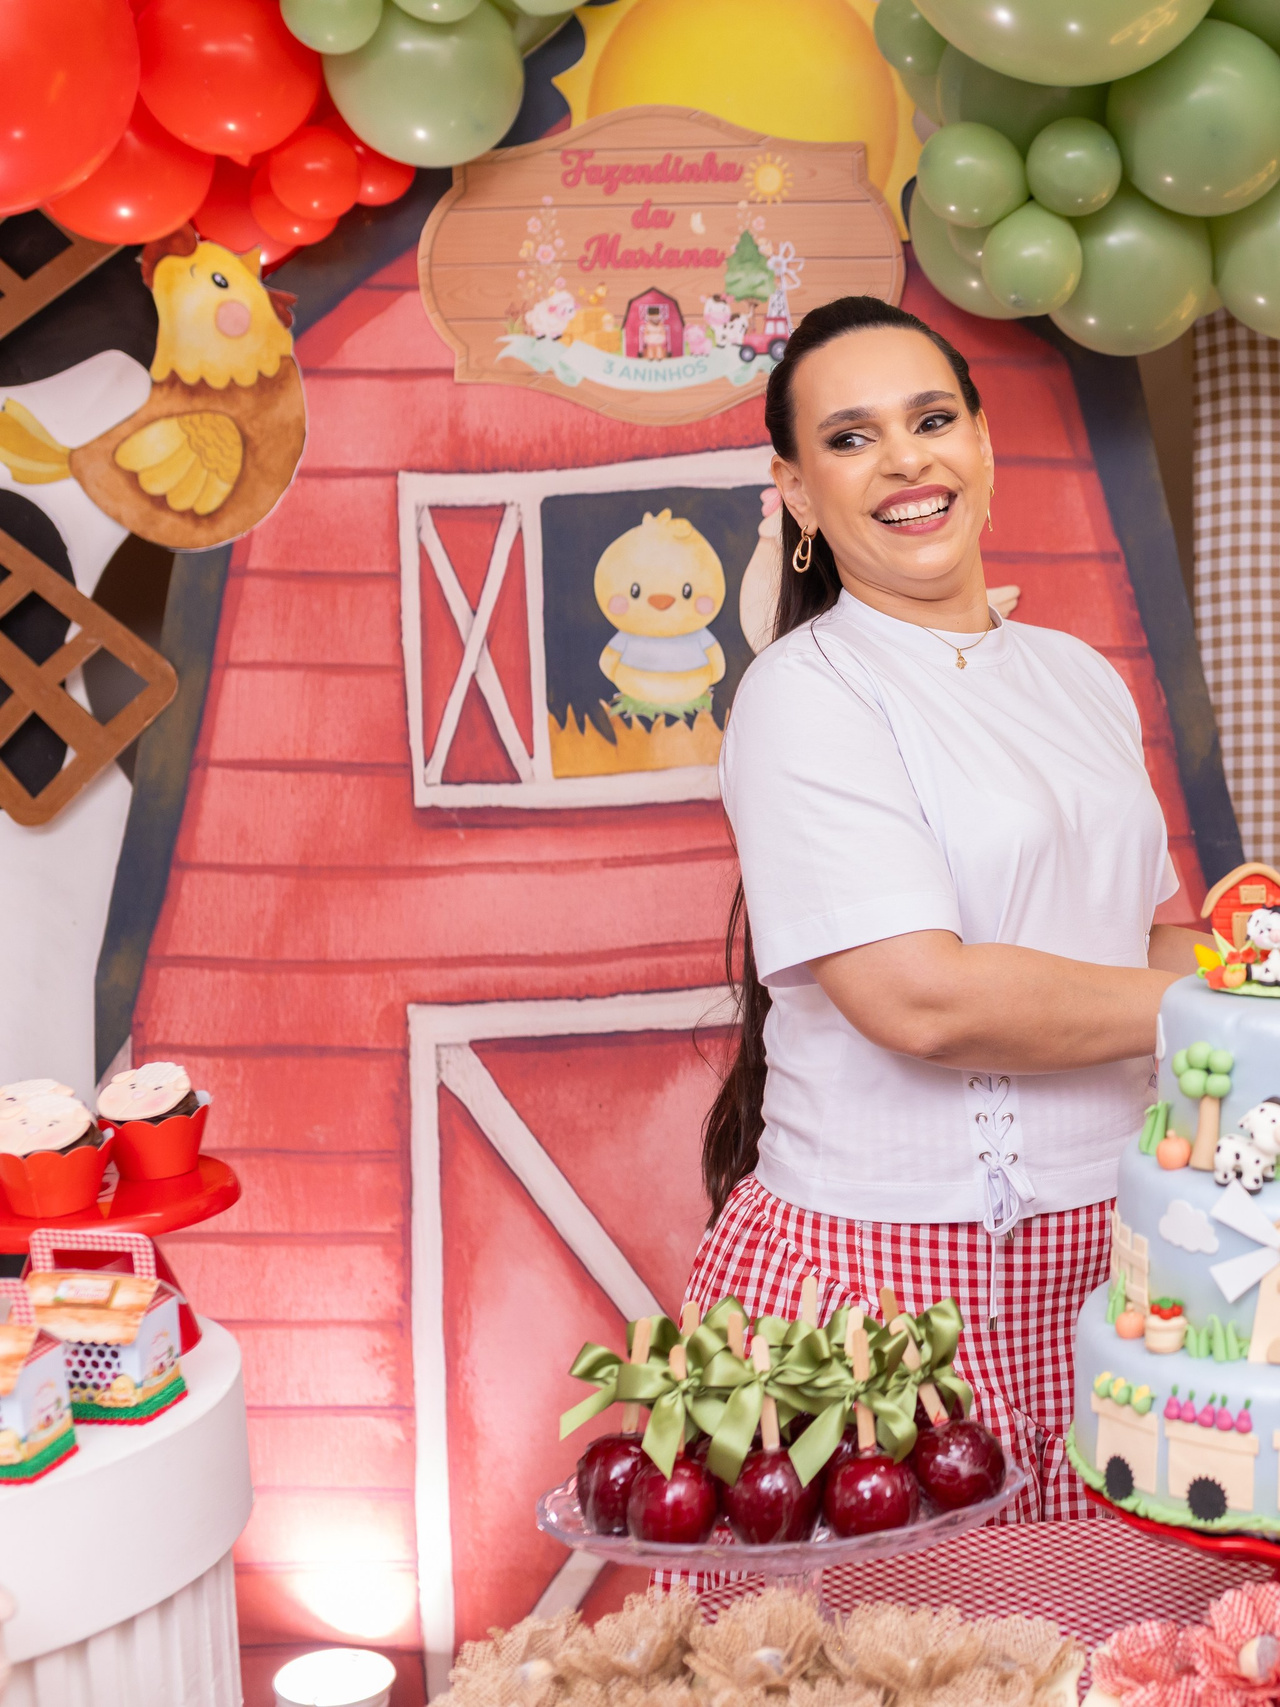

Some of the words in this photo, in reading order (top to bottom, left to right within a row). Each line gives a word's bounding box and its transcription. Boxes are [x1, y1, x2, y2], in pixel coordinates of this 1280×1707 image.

[561, 150, 743, 195] Fazendinha
[631, 199, 675, 229] da
[578, 233, 725, 272] Mariana
[603, 359, 614, 375] 3
[619, 359, 708, 382] ANINHOS
